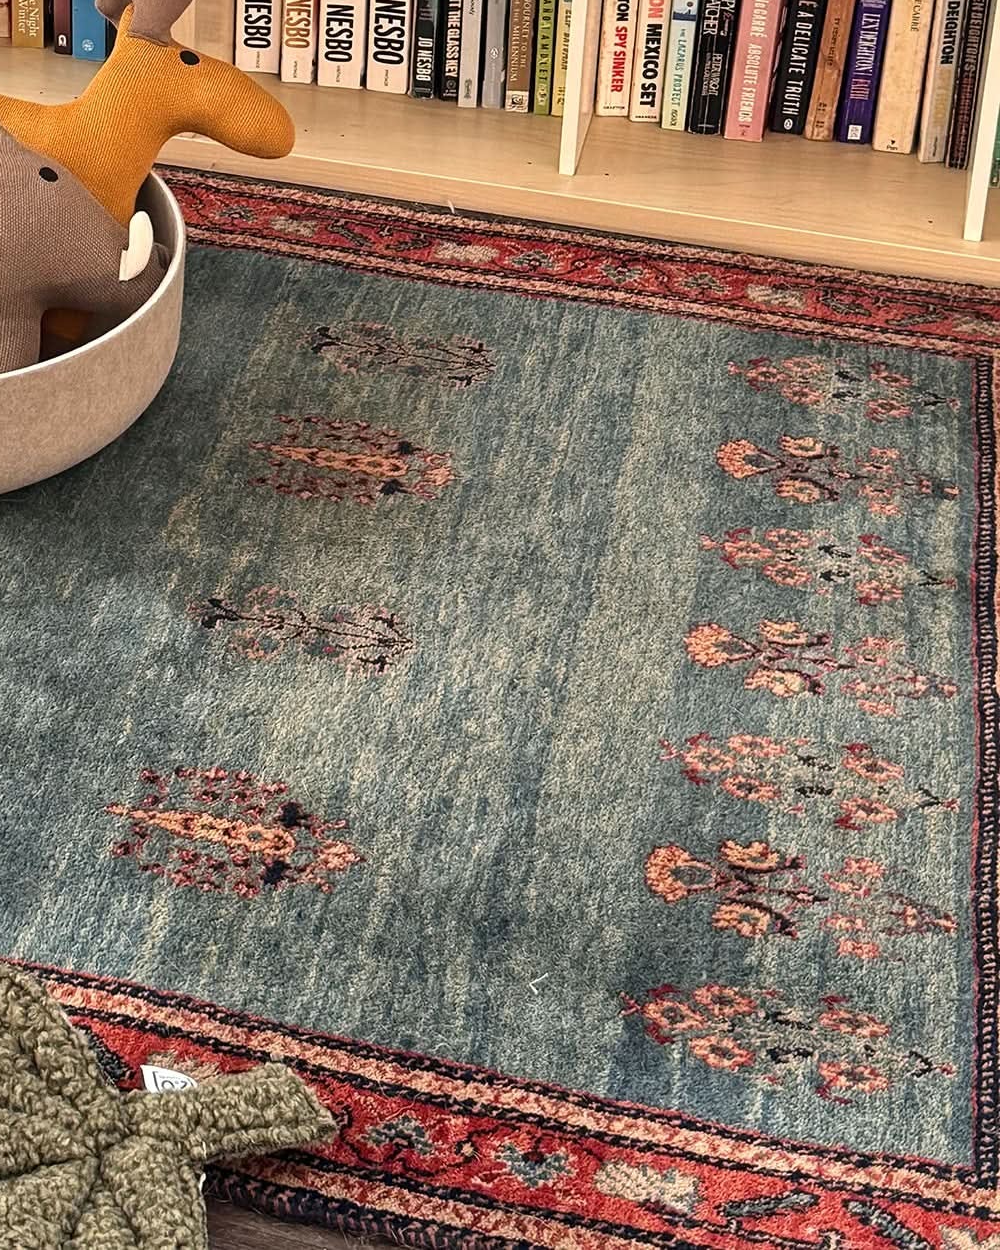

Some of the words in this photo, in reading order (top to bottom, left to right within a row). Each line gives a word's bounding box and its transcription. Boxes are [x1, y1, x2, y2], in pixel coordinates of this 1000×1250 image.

[27, 7, 40, 37] Night
[324, 4, 354, 62] NESBO
[447, 10, 461, 27] THE
[445, 28, 460, 59] GLASS
[614, 26, 628, 48] SPY
[642, 23, 663, 80] MEXICO
[444, 60, 458, 78] KEY
[610, 51, 626, 93] SINKER
[639, 83, 657, 107] SET
